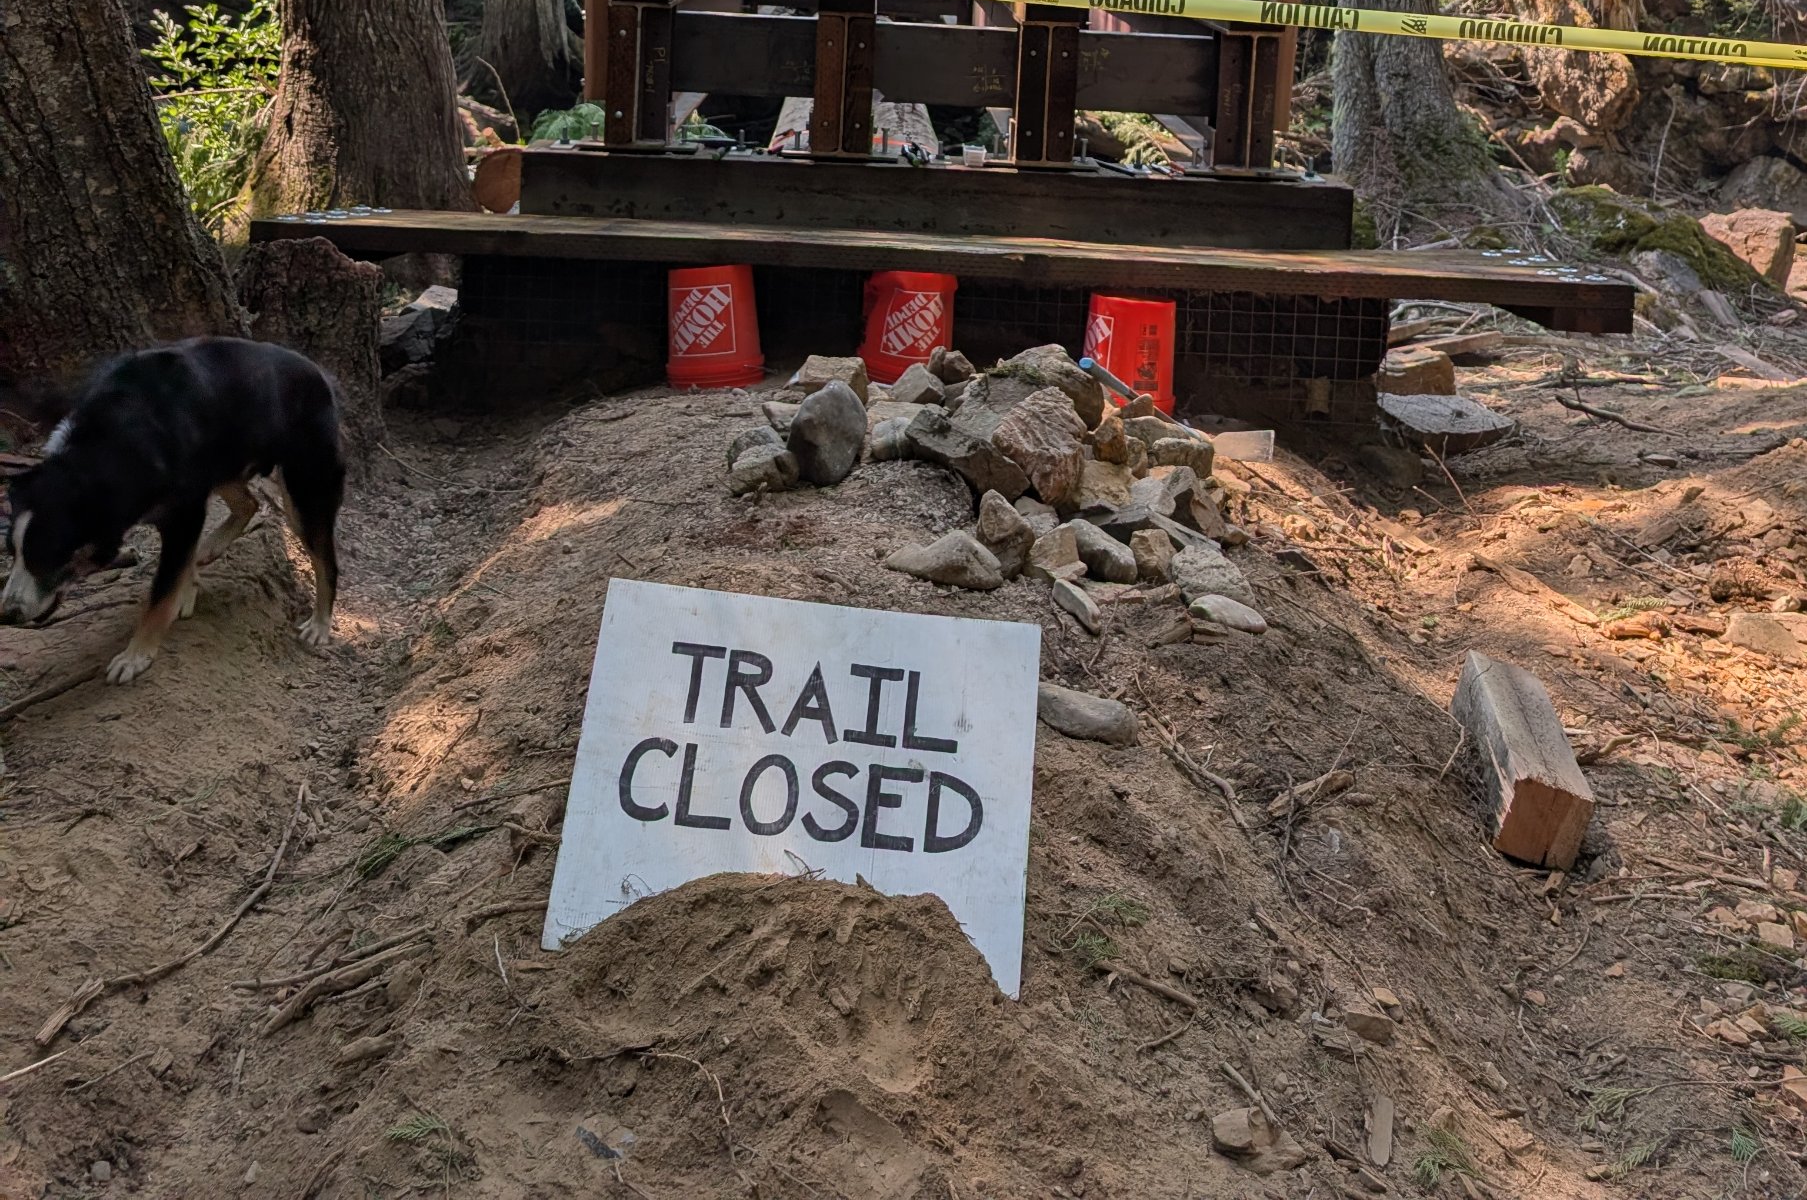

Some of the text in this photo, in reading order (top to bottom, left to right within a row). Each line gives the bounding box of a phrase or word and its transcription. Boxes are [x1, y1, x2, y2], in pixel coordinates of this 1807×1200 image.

[673, 286, 731, 356] HOME
[697, 320, 726, 348] THE
[882, 294, 943, 355] HOME
[886, 293, 928, 330] DEPOT
[914, 326, 941, 352] THE
[672, 641, 958, 754] TRAIL
[619, 736, 984, 854] CLOSED
